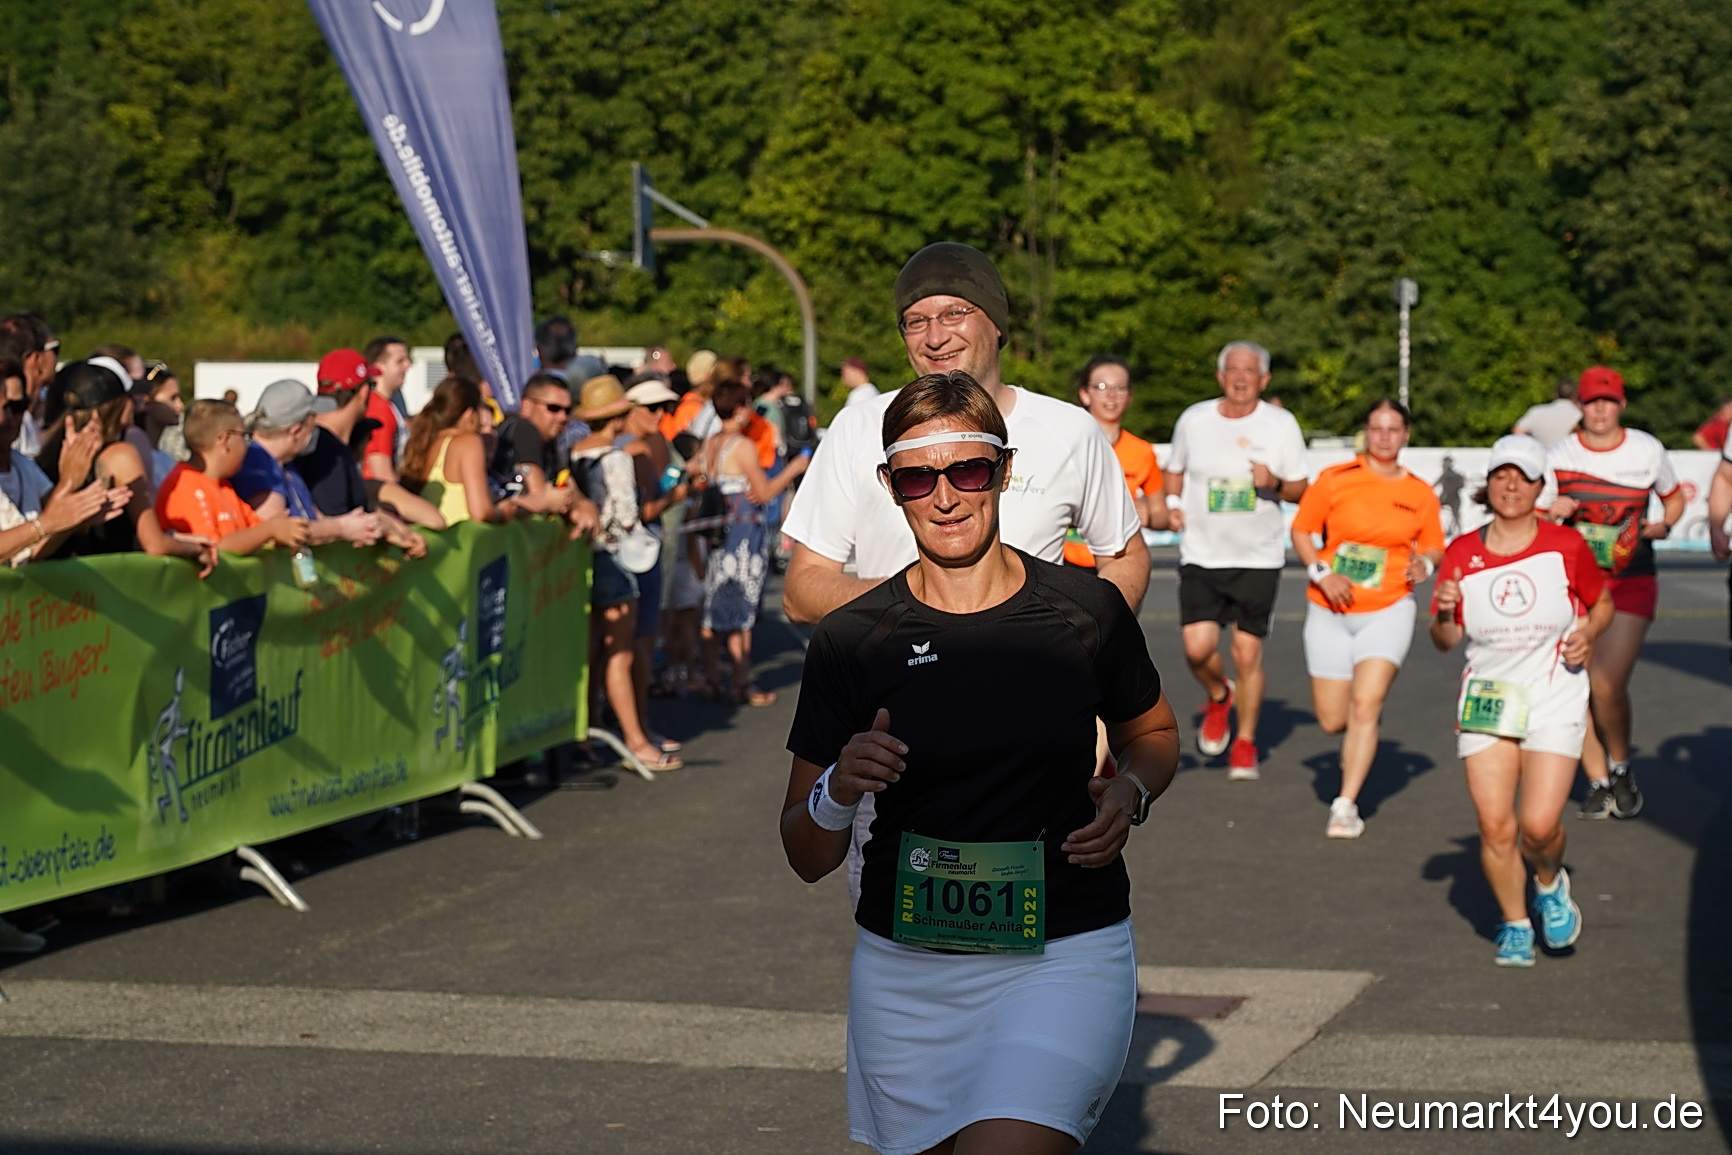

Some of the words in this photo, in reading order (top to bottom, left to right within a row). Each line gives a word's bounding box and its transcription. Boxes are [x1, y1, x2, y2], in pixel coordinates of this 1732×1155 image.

[38, 624, 111, 699] länger!
[907, 653, 938, 666] erima
[184, 669, 303, 788] firmenlauf
[931, 860, 977, 871] Firmenlauf
[902, 884, 914, 923] RUN
[919, 877, 1014, 918] 1061
[1023, 887, 1037, 938] 2022
[913, 913, 985, 932] Schmaußer
[988, 921, 1023, 932] Anita
